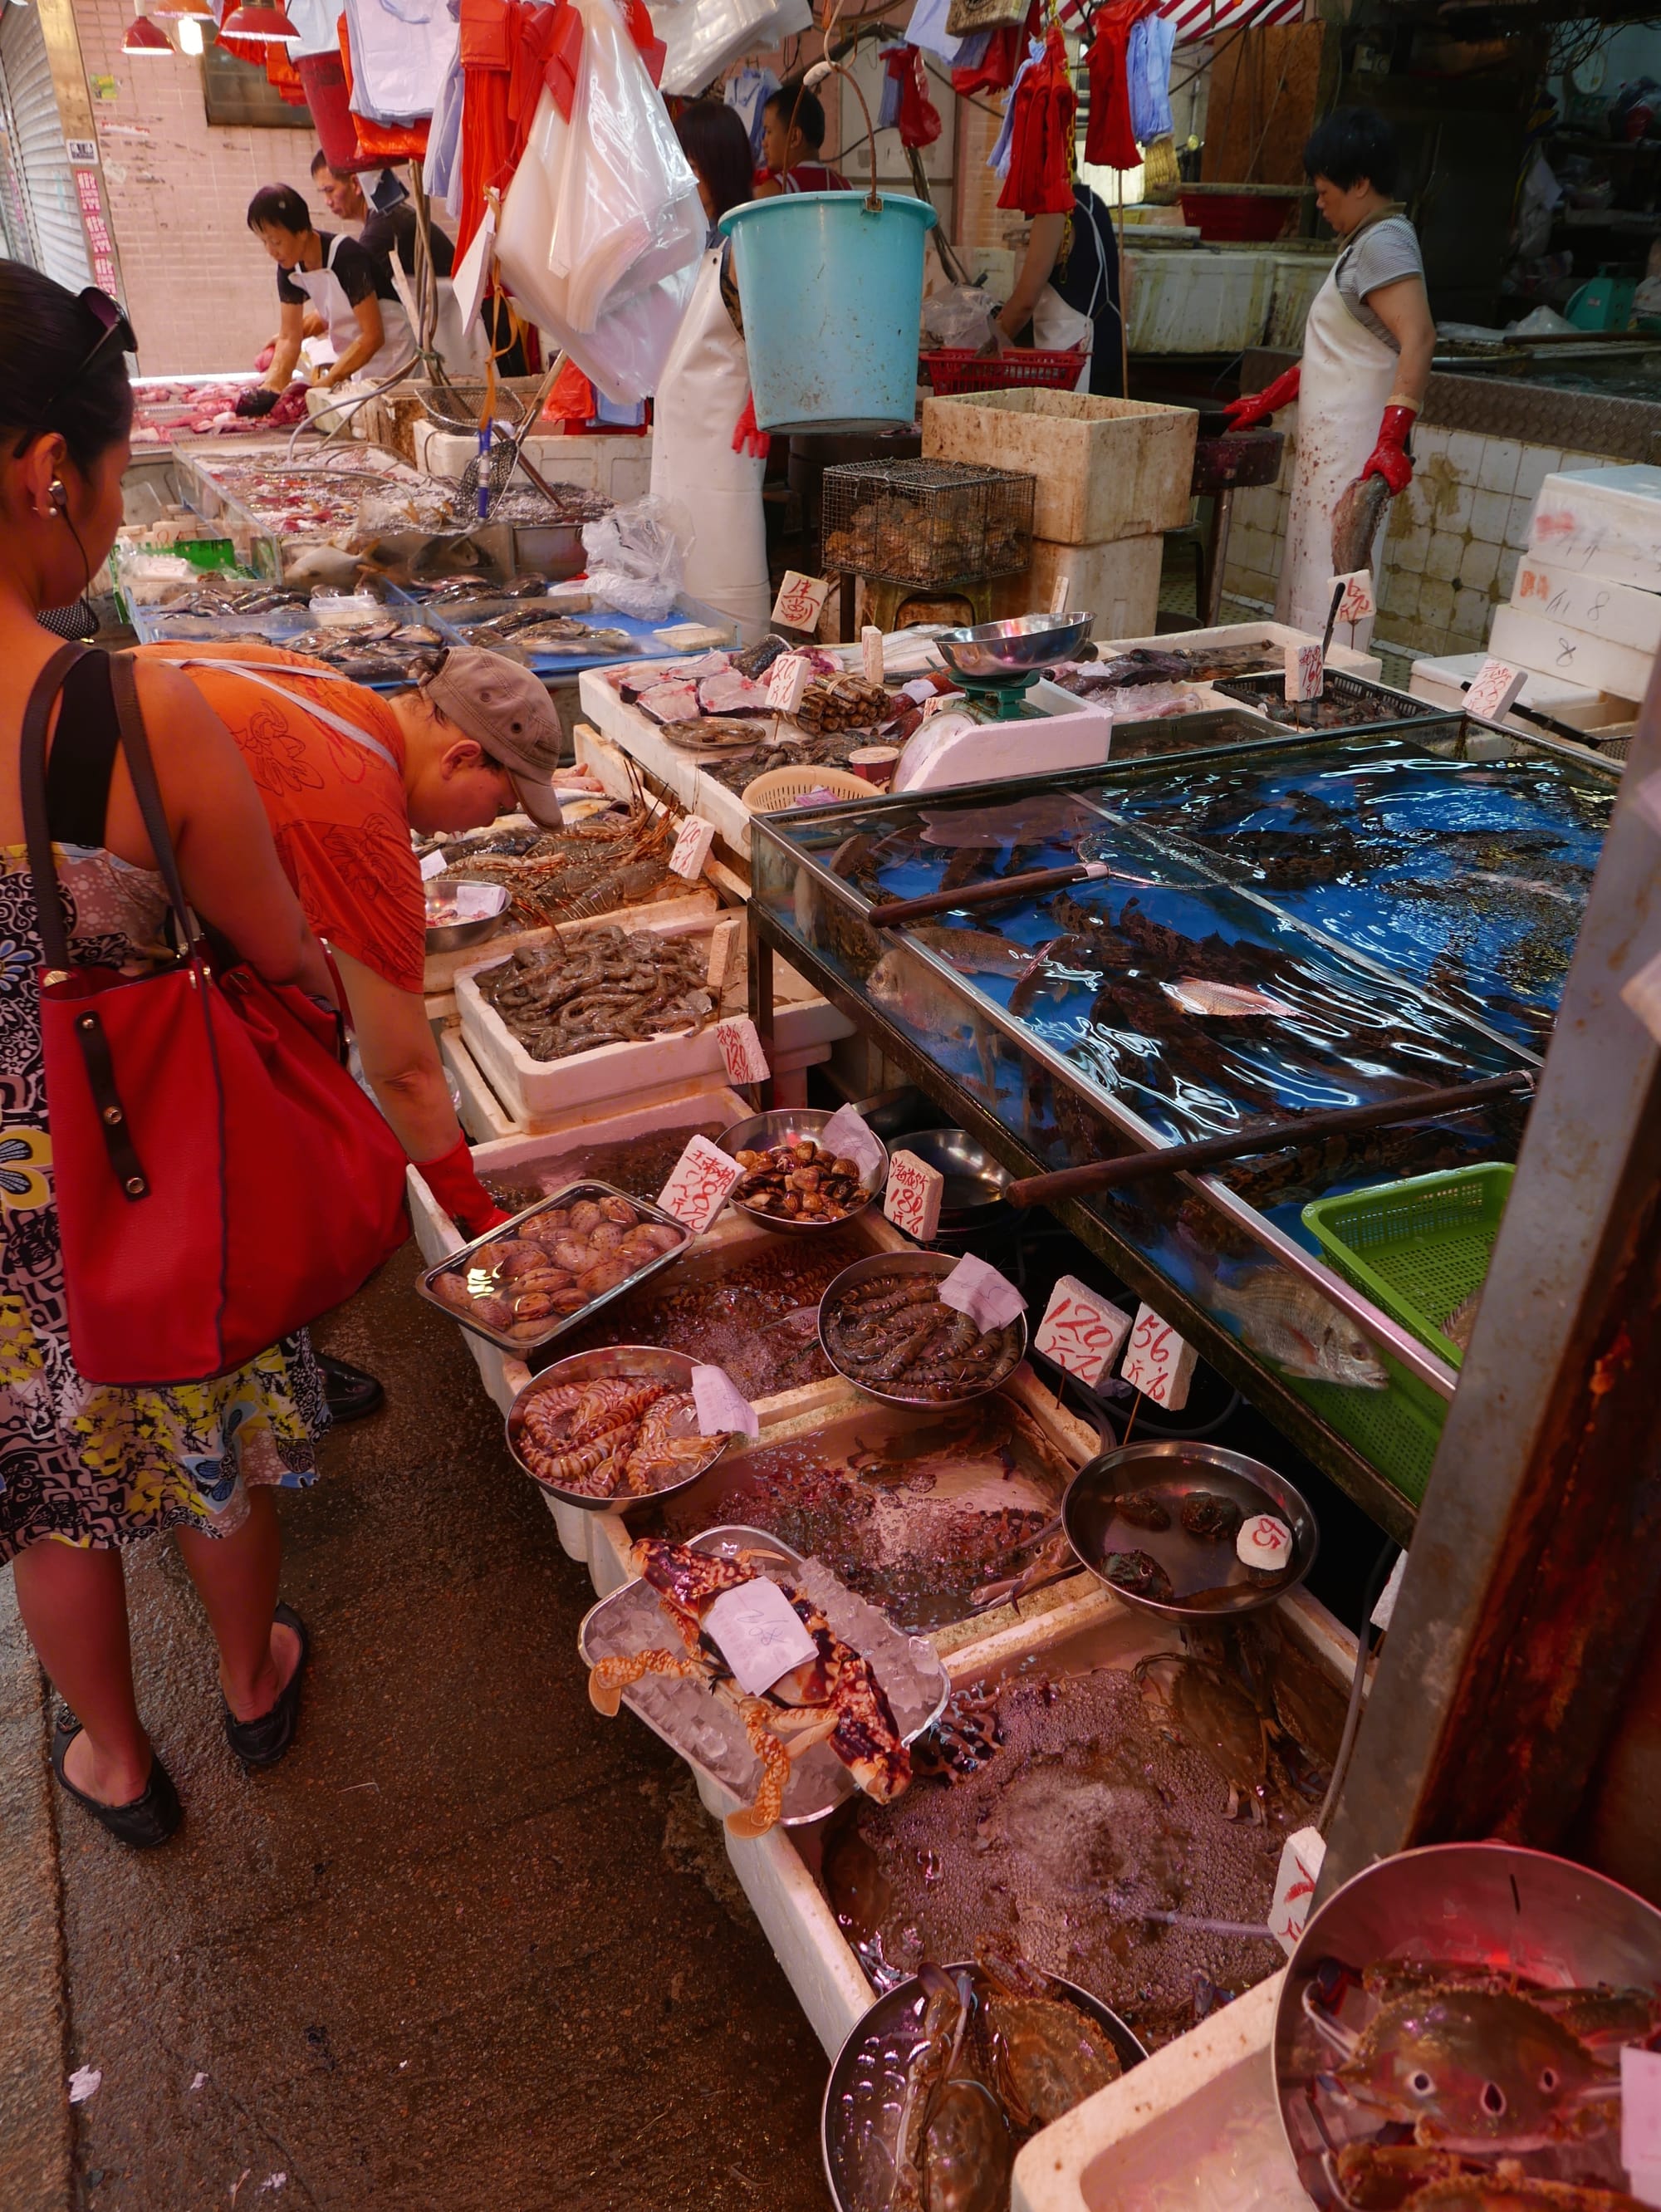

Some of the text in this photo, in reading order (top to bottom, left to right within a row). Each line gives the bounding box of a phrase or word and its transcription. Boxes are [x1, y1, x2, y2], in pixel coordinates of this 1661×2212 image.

[726, 1043, 746, 1075] 120
[890, 1188, 924, 1216] 180
[1044, 1297, 1114, 1349] 120
[1133, 1314, 1173, 1363] 56
